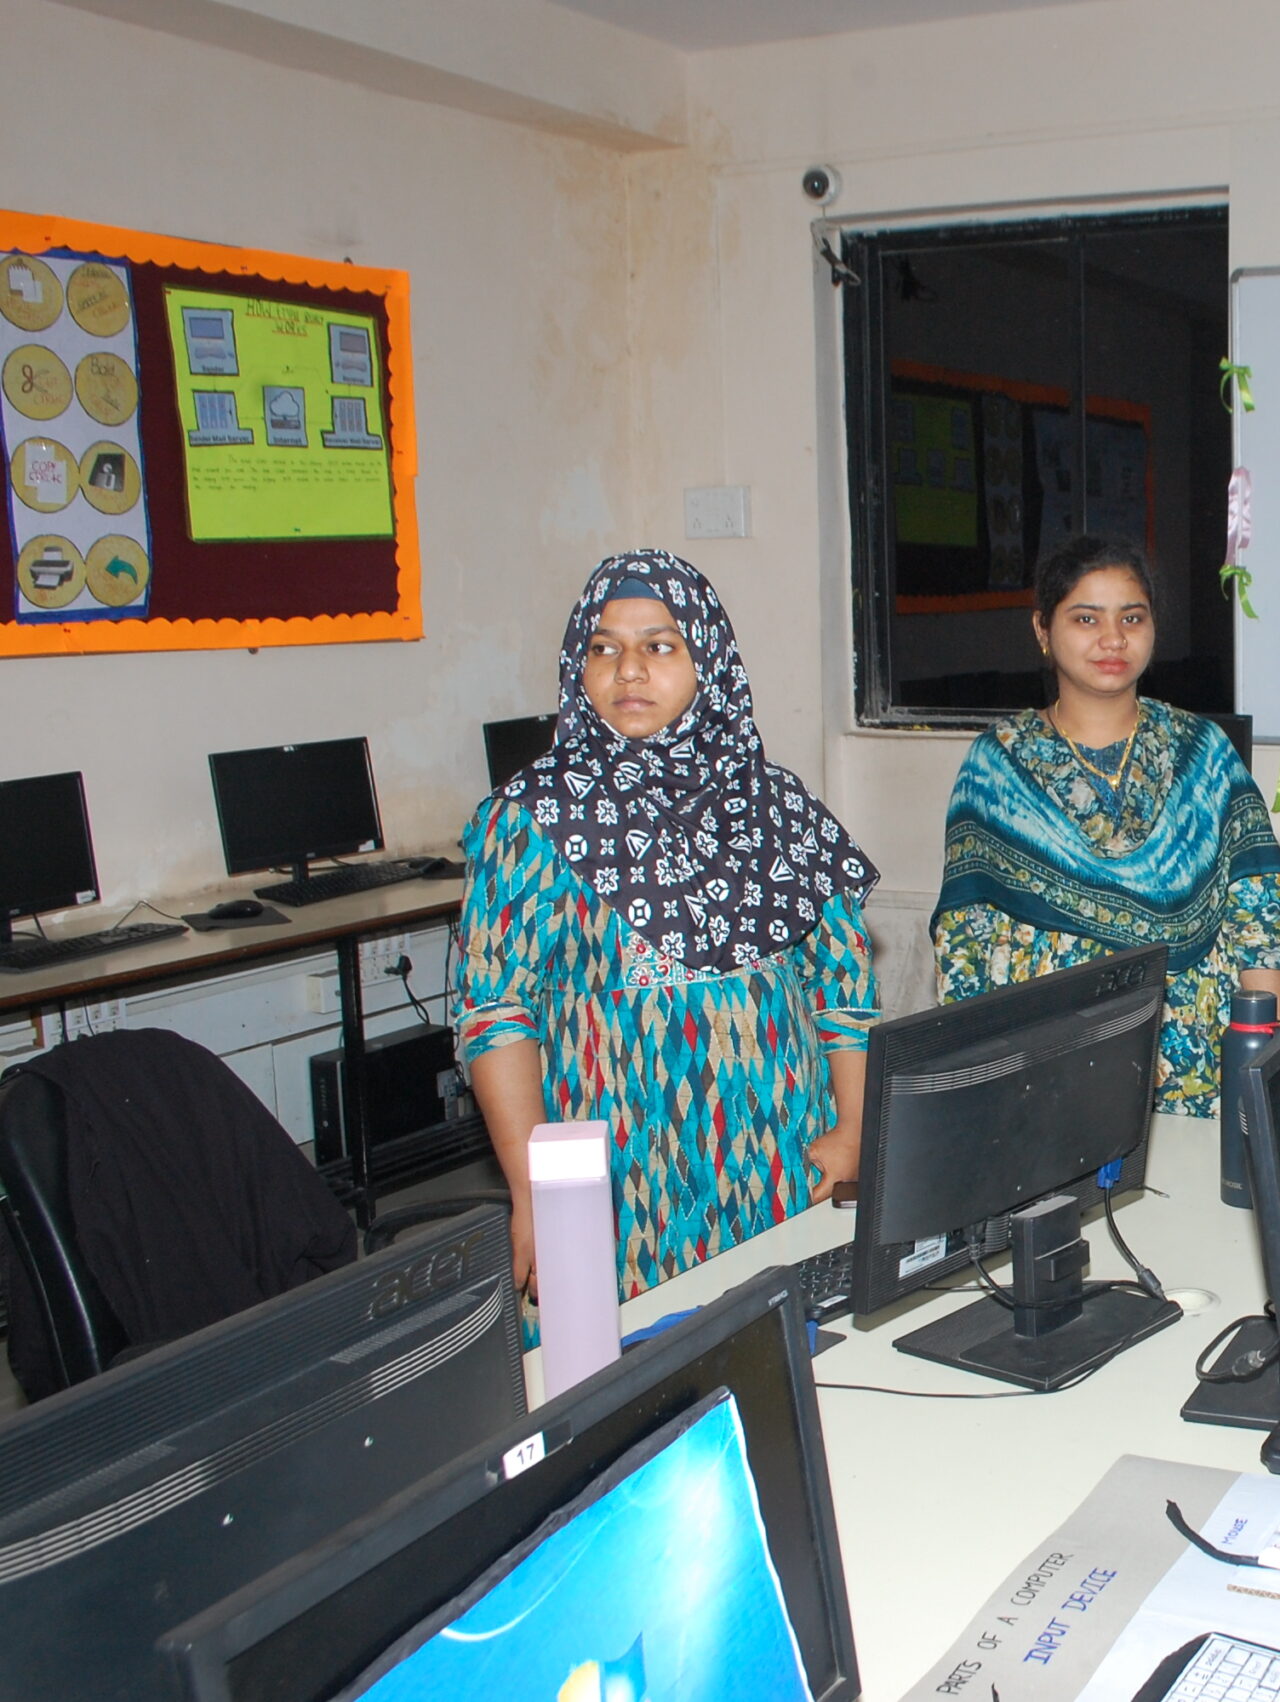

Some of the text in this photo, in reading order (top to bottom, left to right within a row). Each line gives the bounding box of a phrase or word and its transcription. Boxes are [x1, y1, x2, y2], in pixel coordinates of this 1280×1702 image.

[368, 1230, 486, 1321] acer
[516, 1442, 535, 1465] 17
[1221, 1517, 1248, 1545] MOUSE
[936, 1552, 1075, 1696] PARTS OF A COMPUTER
[1023, 1567, 1118, 1665] INPUT DEVICE
